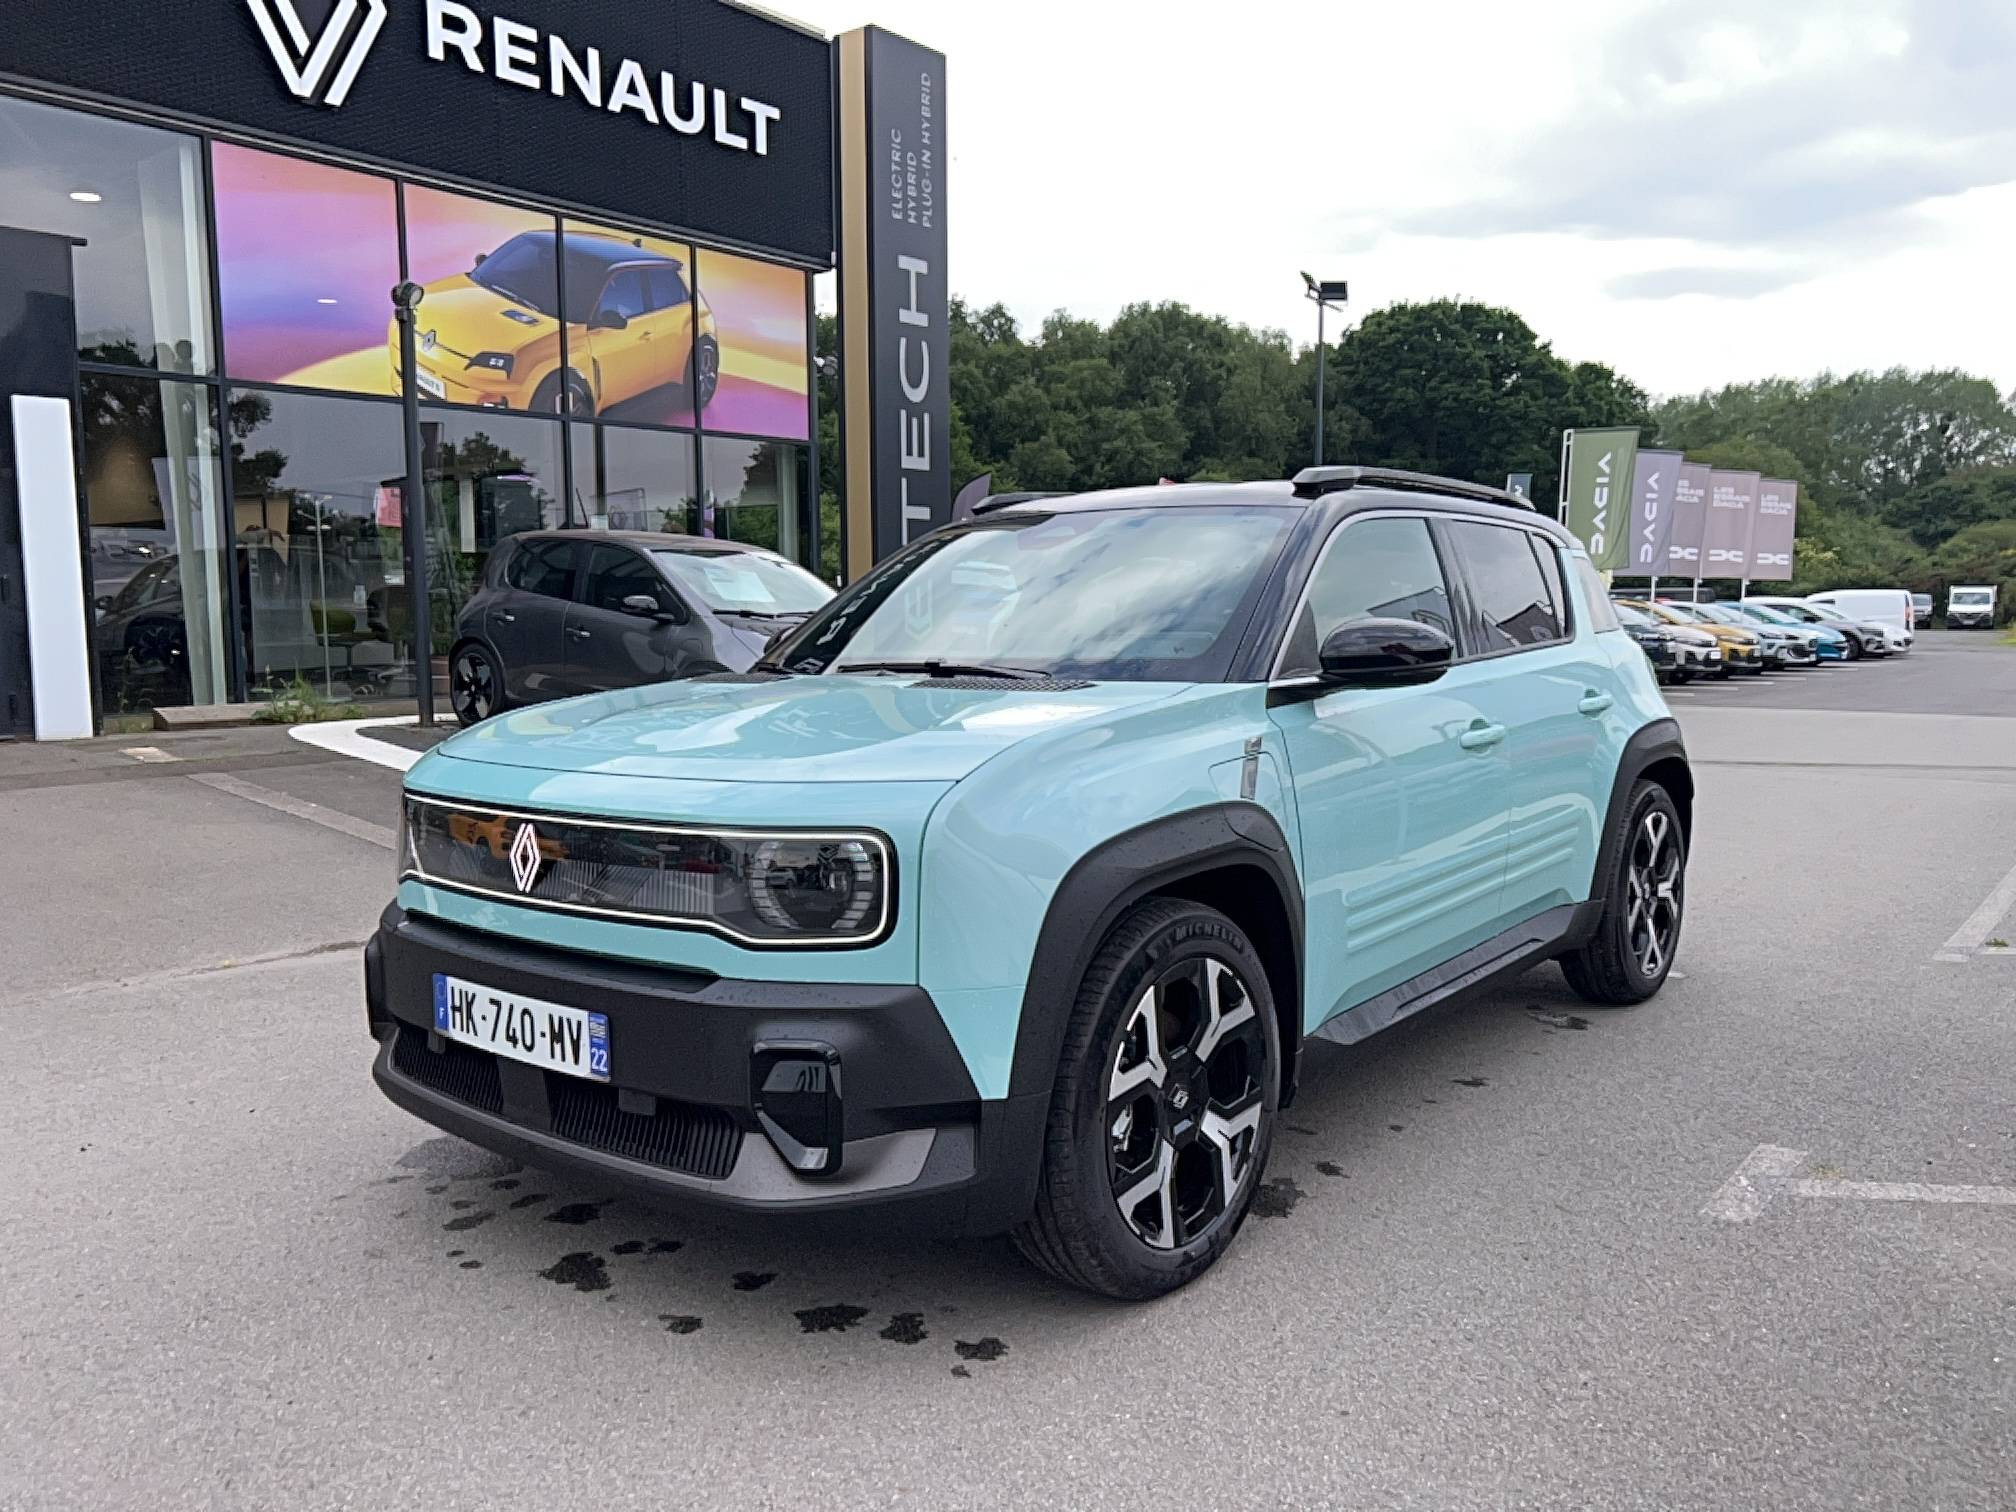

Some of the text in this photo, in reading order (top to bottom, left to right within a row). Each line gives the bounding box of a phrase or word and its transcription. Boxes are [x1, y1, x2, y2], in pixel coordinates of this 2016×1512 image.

[425, 0, 781, 156] RENAULT
[891, 128, 903, 220] ELECTRIC
[906, 151, 918, 224] HYBRID
[920, 72, 933, 228] PLUG-IN HYBRID
[1590, 451, 1612, 554] DACIA
[1640, 471, 1660, 563] DACIA
[1175, 921, 1243, 950] MICHELIN
[438, 1006, 445, 1019] F
[450, 986, 582, 1066] HK-740-MV
[591, 1048, 608, 1072] 22
